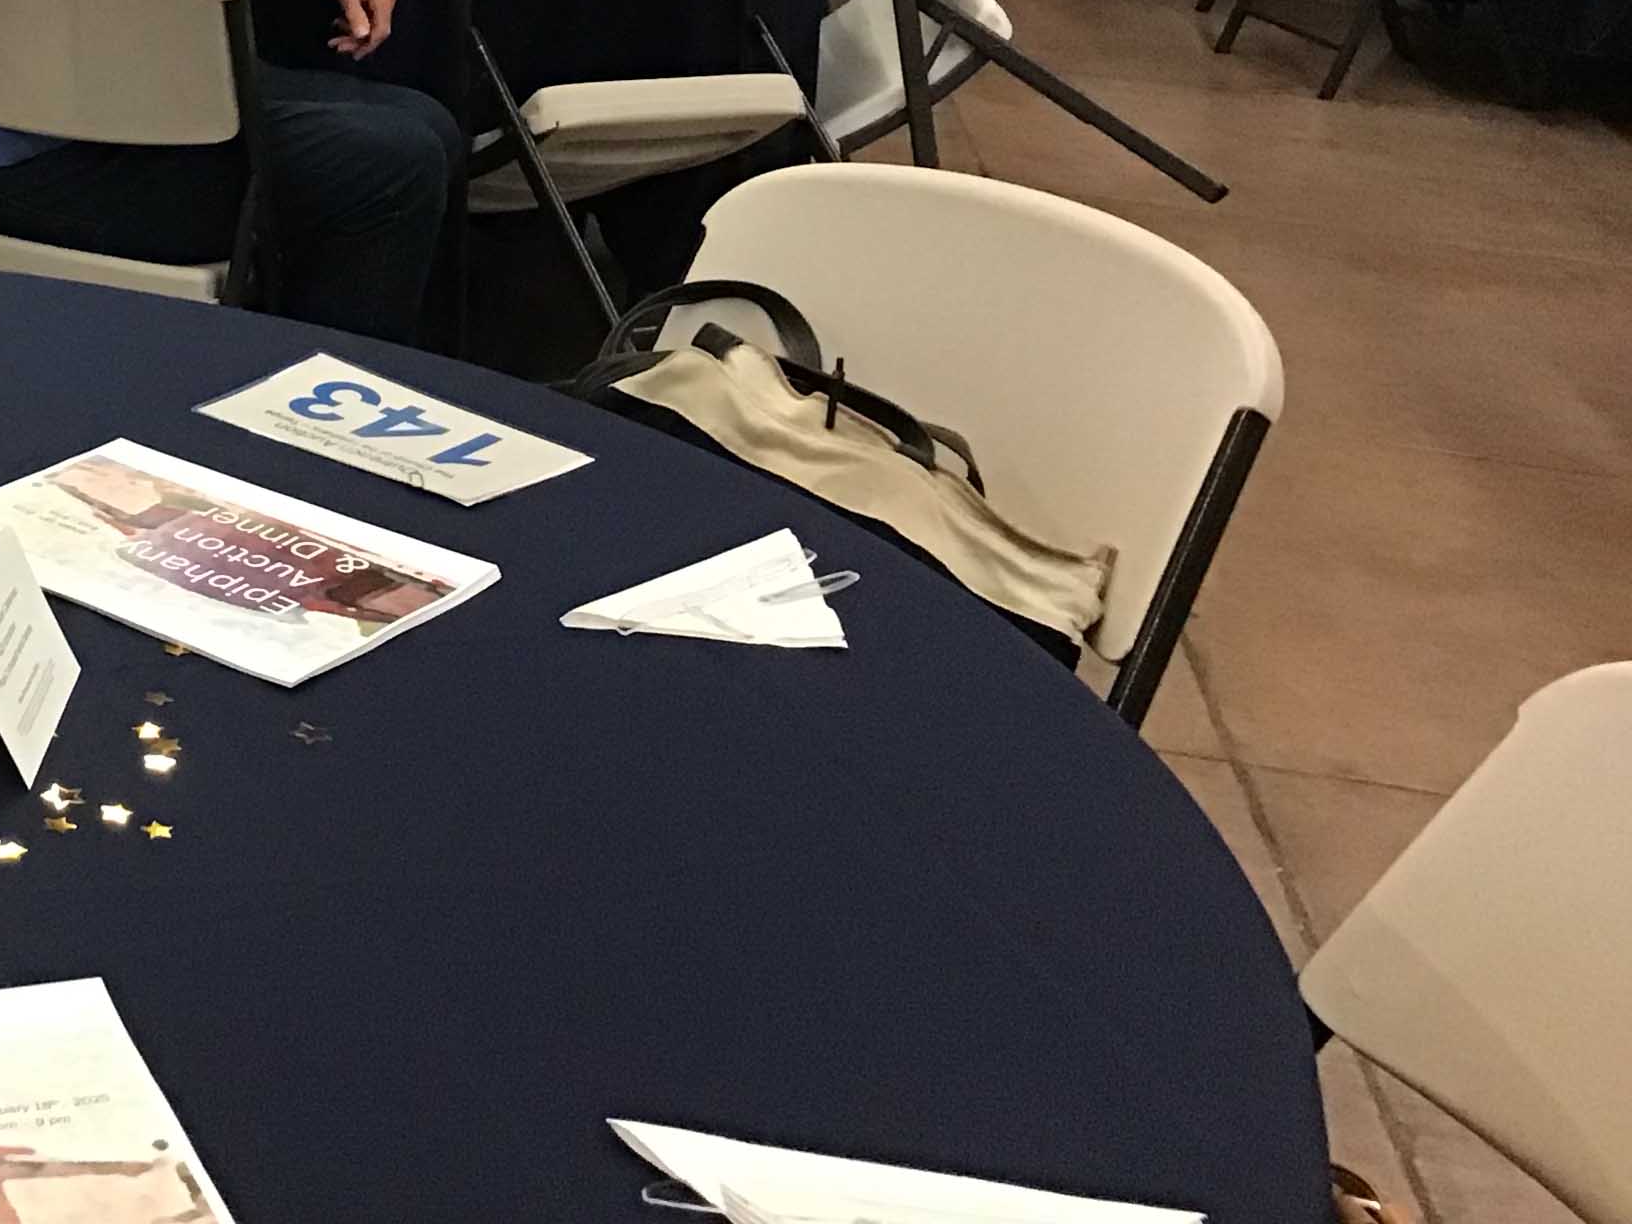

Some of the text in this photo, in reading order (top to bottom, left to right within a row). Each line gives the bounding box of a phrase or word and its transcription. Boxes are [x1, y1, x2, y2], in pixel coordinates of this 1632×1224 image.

[289, 381, 502, 466] 143
[173, 526, 325, 590] Auction
[191, 507, 371, 574] & Dinner
[118, 539, 301, 616] Epiphany
